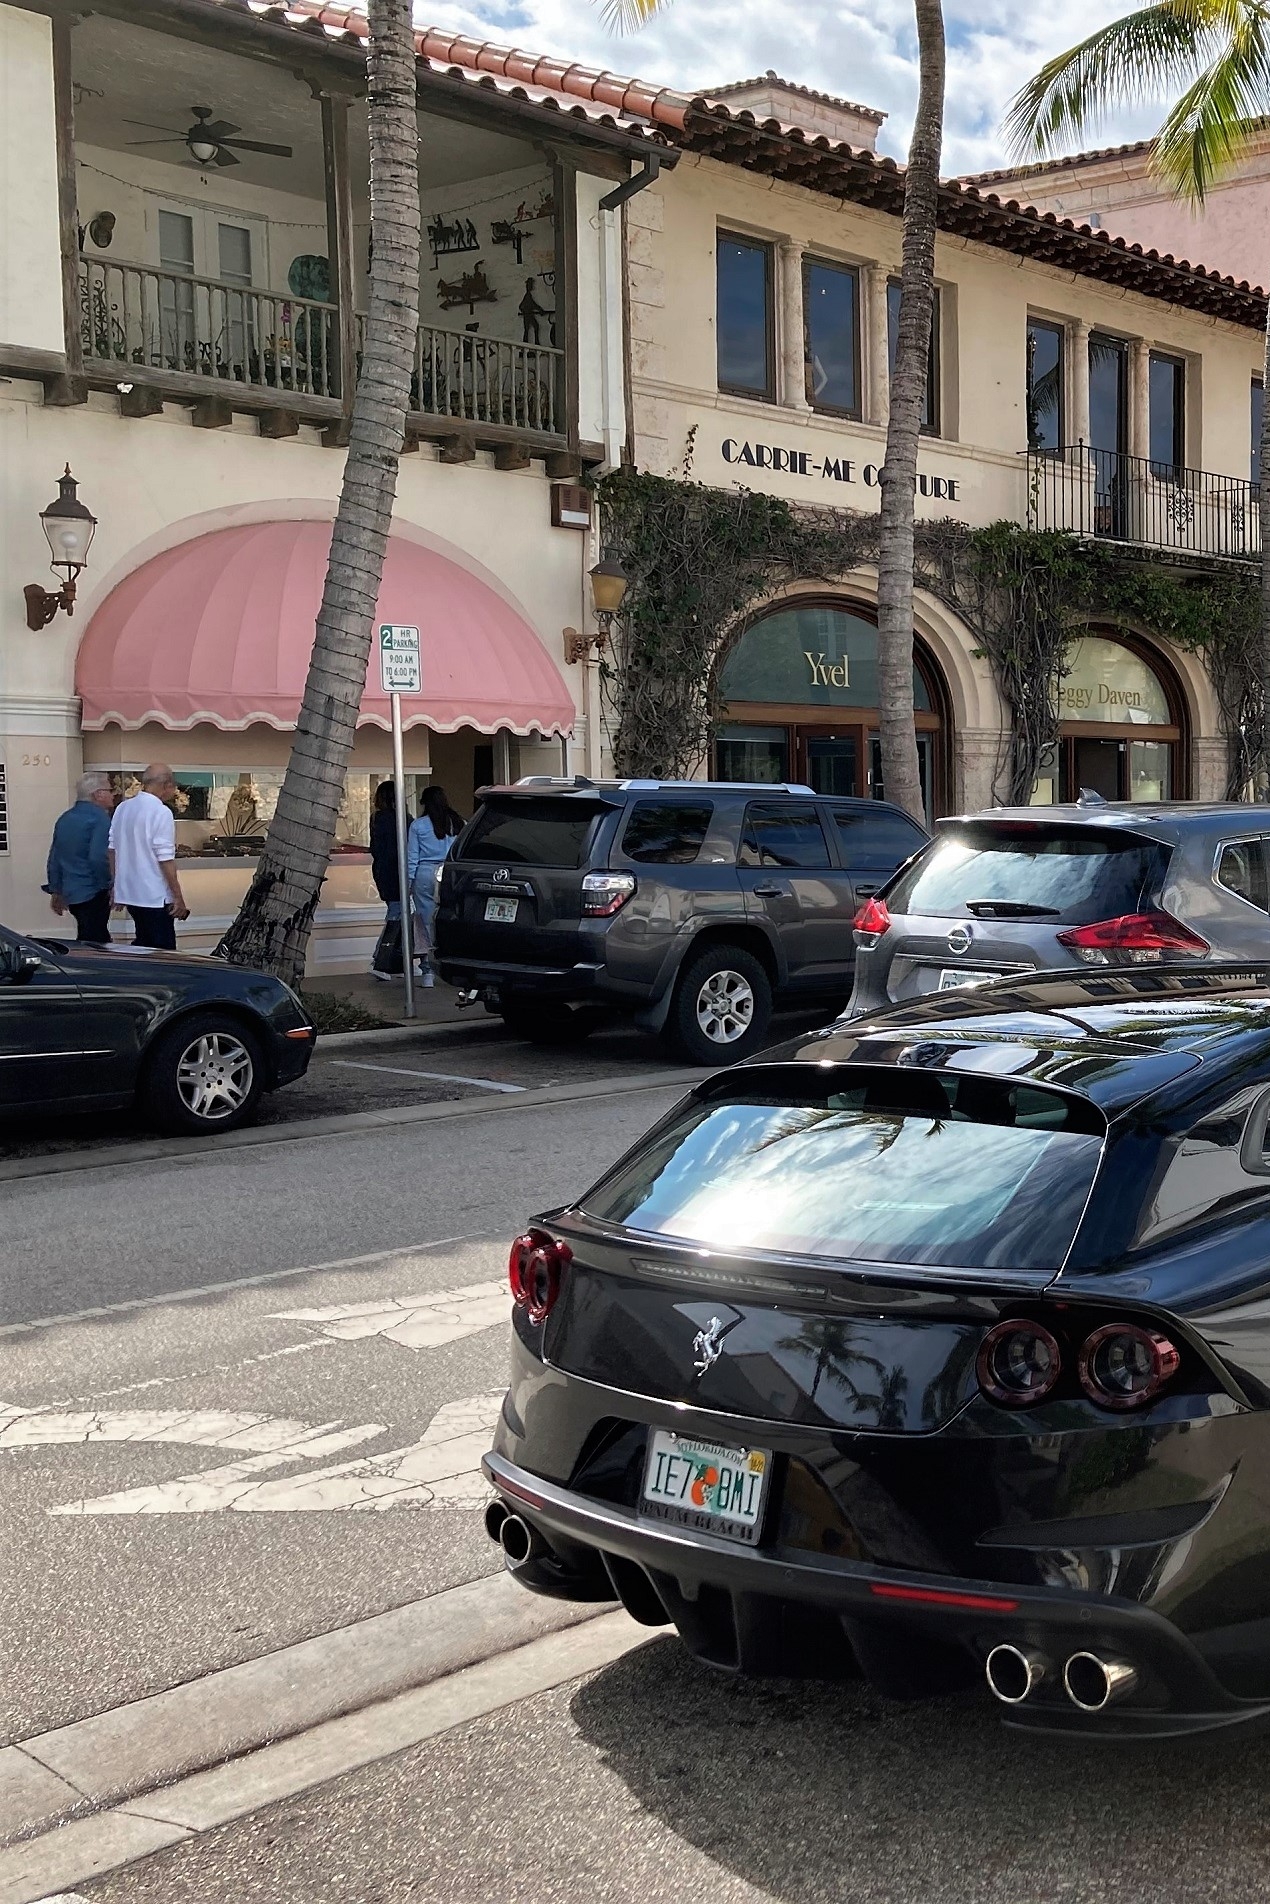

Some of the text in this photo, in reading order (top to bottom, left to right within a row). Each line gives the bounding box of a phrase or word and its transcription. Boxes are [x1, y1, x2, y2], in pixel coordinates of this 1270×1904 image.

[721, 438, 960, 502] CARRIE-ME CURE
[382, 629, 392, 647] 2
[400, 629, 411, 638] HR
[393, 638, 418, 649] PARKING
[404, 655, 414, 664] AM
[385, 666, 393, 676] TO
[408, 668, 417, 677] PM
[803, 651, 851, 688] Yvel
[1098, 683, 1141, 706] Daven
[22, 754, 51, 767] 250
